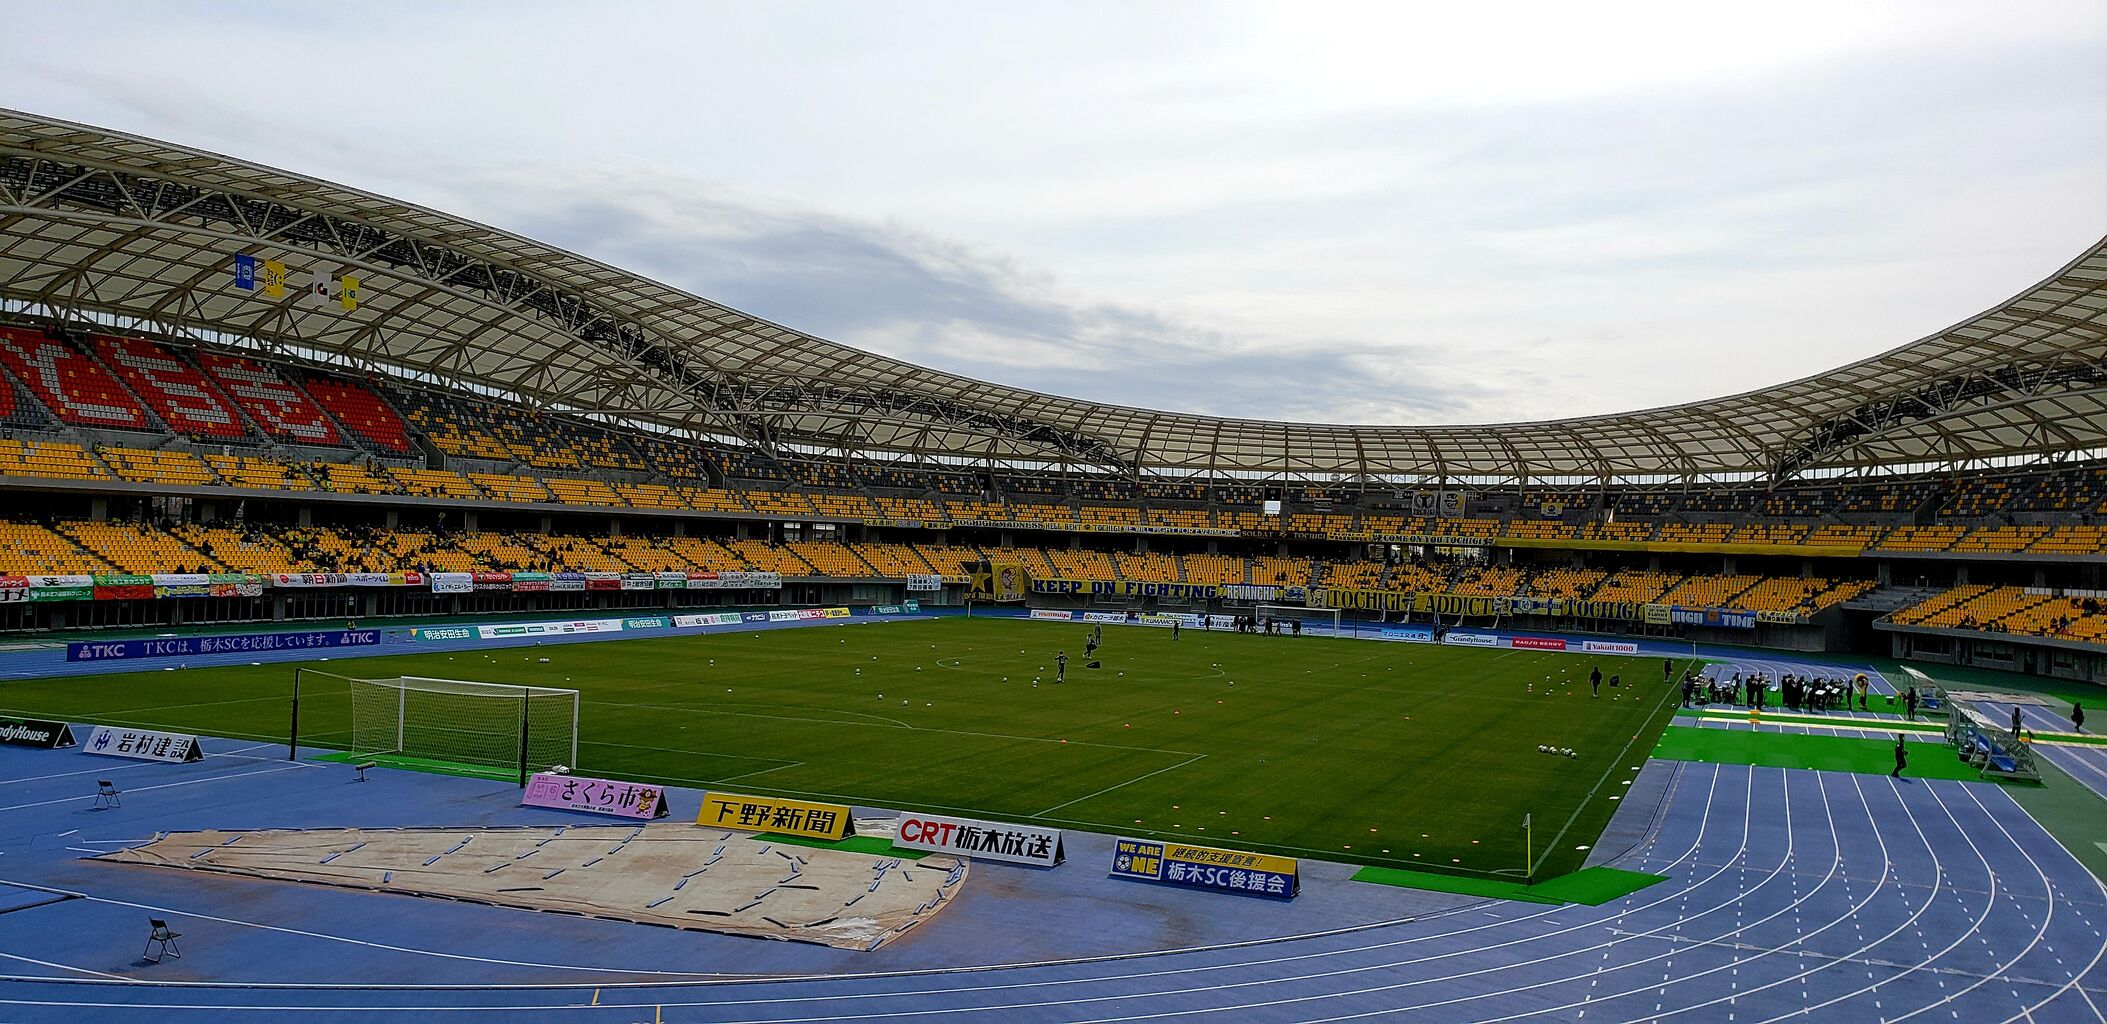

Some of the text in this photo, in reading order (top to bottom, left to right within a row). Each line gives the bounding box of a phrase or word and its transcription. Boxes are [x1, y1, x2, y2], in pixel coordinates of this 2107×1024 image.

[1242, 530, 1274, 538] SOLDAT
[1383, 534, 1407, 542] COME
[301, 574, 388, 584] 朝日新聞 スポーツくじ
[1033, 579, 1216, 598] KEEP ON FIGHTING
[1227, 585, 1276, 600] REVANCHA
[1328, 589, 1400, 611] TOCHIGI
[1561, 599, 1645, 620] TOCHIGI
[1671, 611, 1703, 624] HIGH
[1722, 614, 1756, 628] TIME
[350, 632, 374, 643] TKC
[424, 628, 470, 640] 明治安田生命
[1453, 635, 1492, 644] GrandyHouse
[92, 644, 125, 657] TKC
[117, 732, 189, 760] 岩村建設
[562, 780, 641, 809] さくら市
[711, 800, 837, 834] 下野新聞
[900, 818, 1053, 860] CRT栃木放送
[1119, 842, 1161, 857] WE ARE
[1167, 862, 1286, 894] 栃木SC後援会
